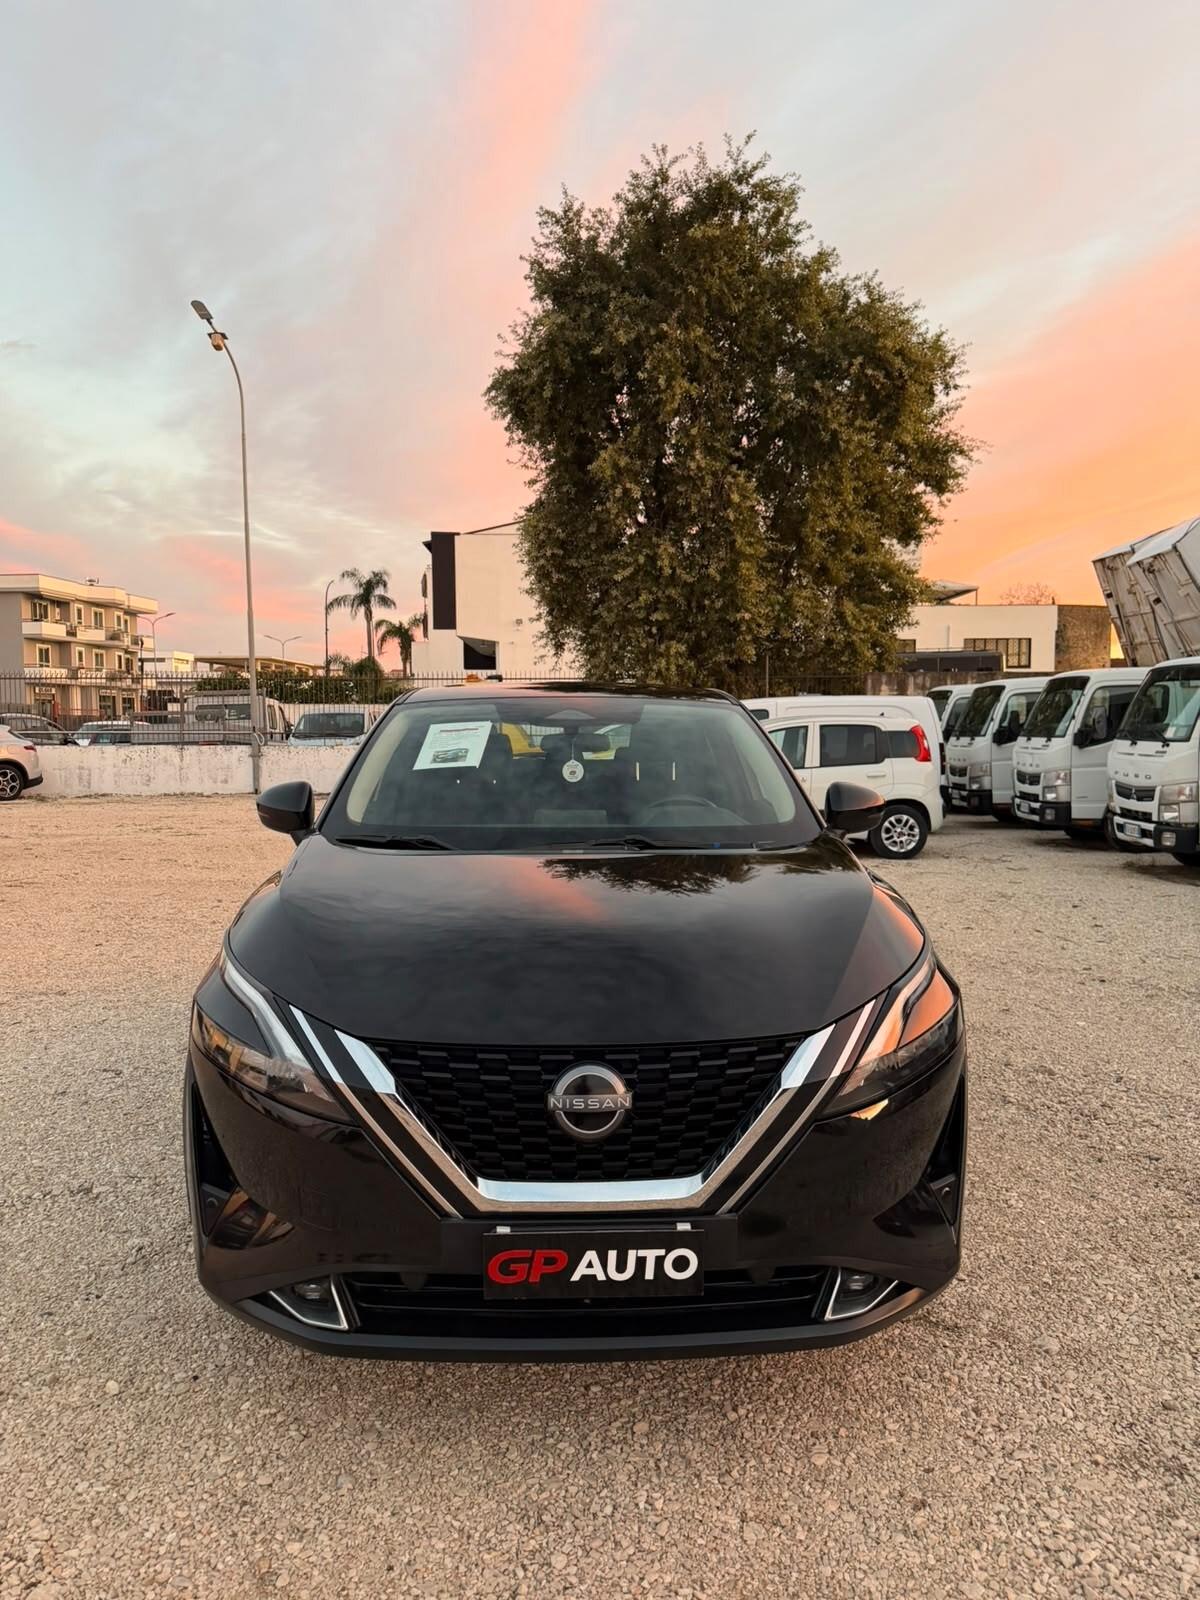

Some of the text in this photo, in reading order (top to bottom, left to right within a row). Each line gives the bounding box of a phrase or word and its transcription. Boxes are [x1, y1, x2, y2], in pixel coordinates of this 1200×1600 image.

[550, 1097, 630, 1109] NISSAN
[487, 1247, 699, 1284] GP AUTO
